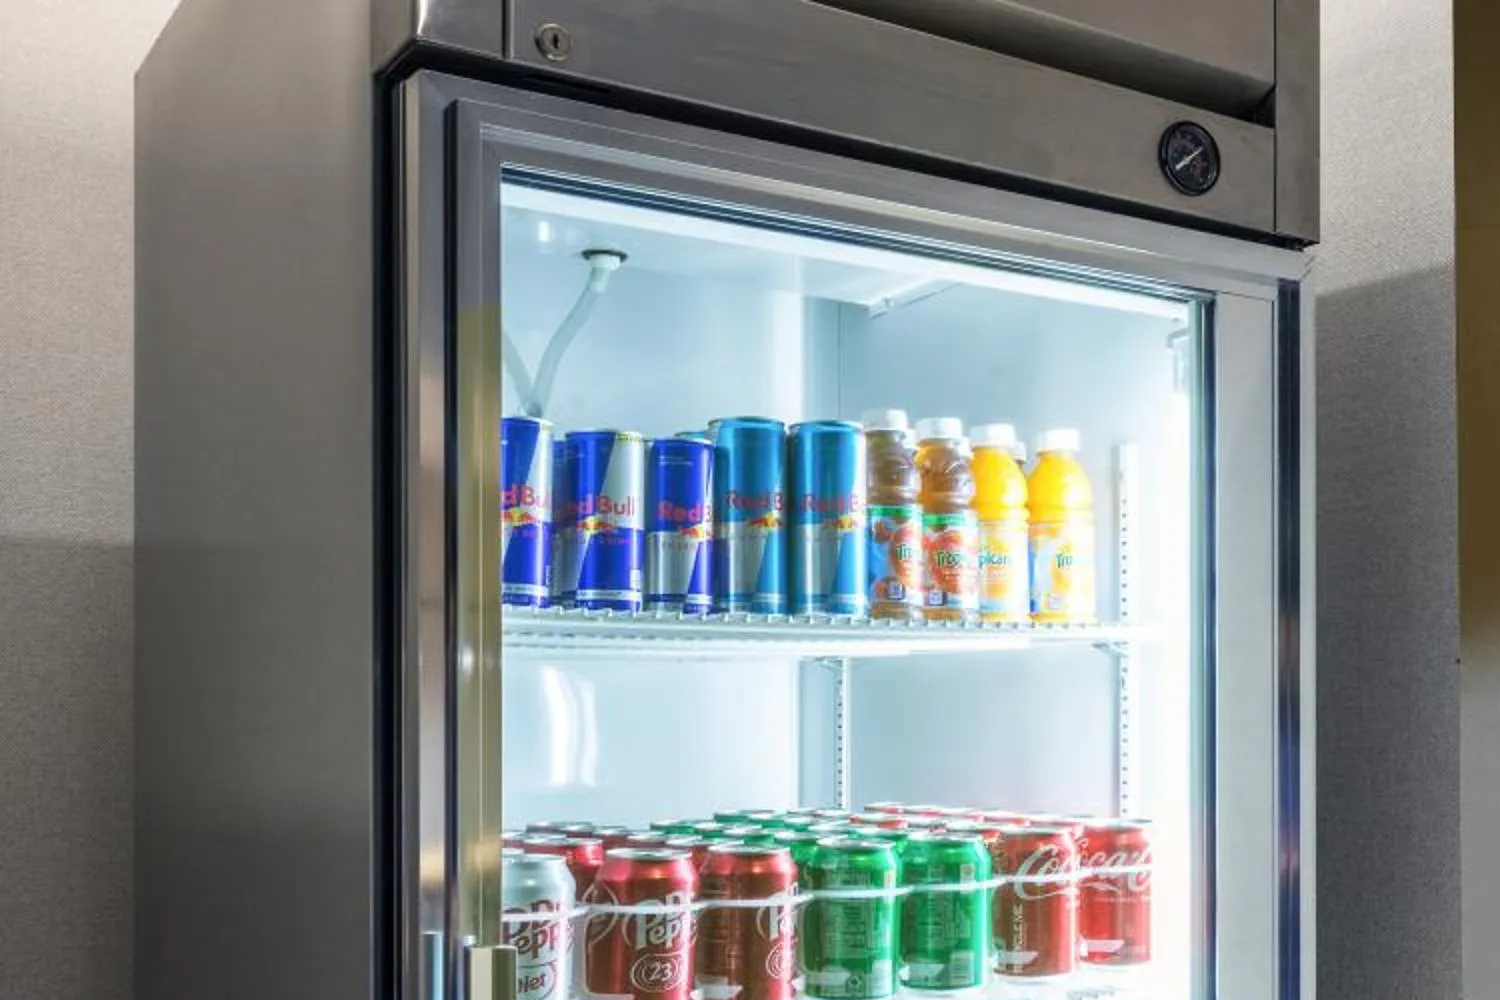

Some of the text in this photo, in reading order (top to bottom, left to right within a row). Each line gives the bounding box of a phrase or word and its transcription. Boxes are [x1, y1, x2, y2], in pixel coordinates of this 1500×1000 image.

[598, 496, 634, 516] Bull
[658, 501, 697, 522] Red
[649, 962, 672, 981] 23
